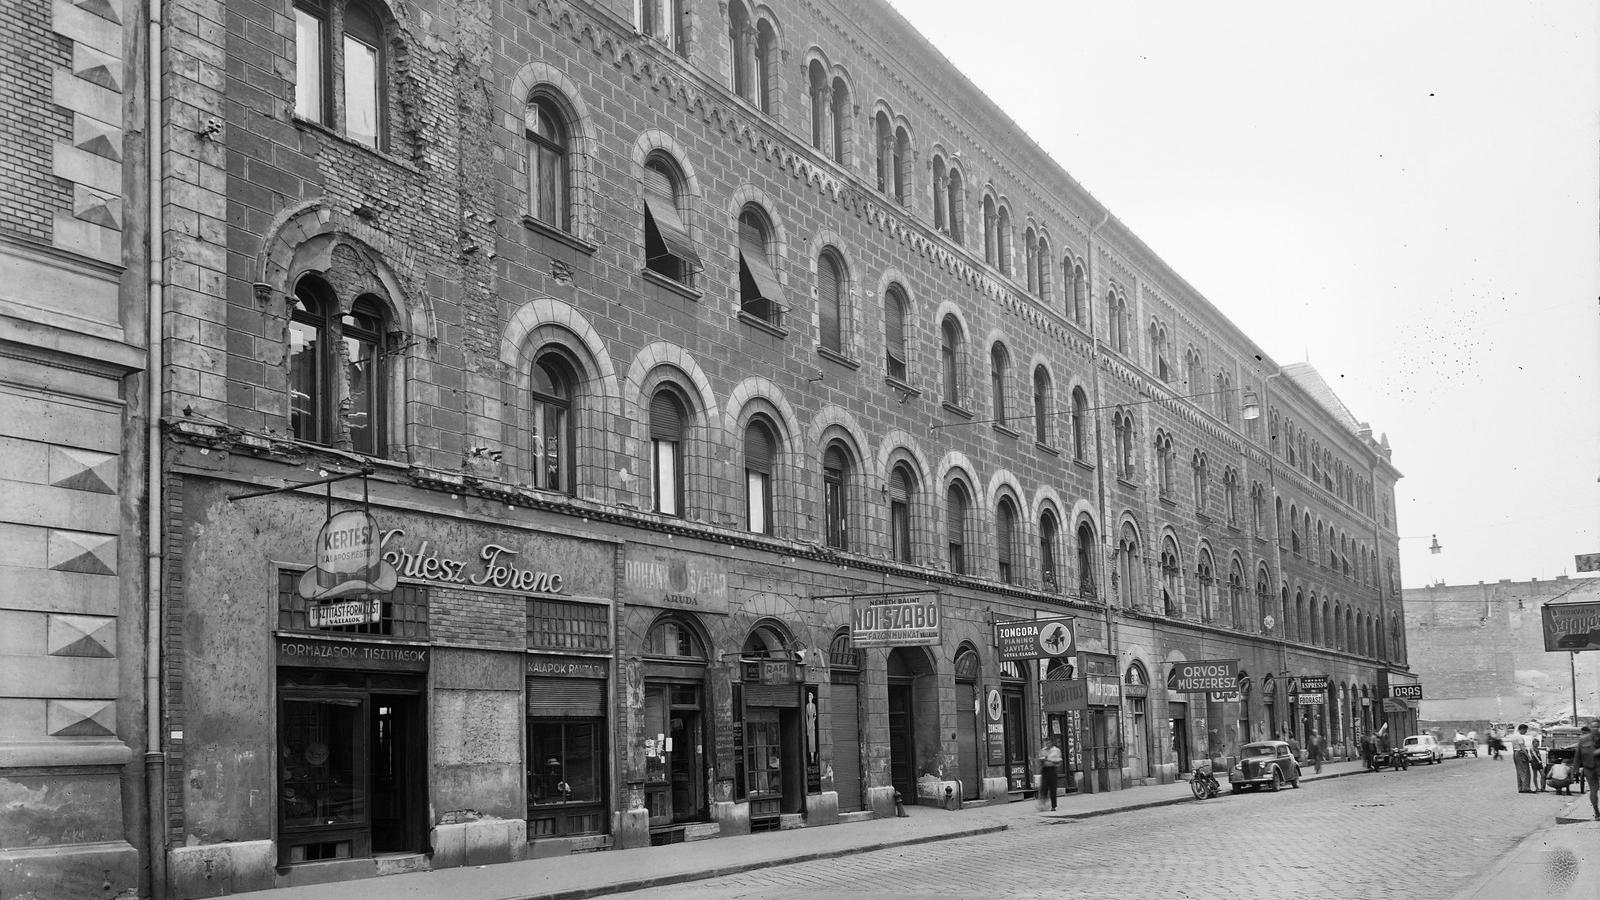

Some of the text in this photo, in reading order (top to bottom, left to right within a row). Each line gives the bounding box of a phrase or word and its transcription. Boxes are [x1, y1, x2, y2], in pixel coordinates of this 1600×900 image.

[470, 544, 563, 593] Ferenc
[1000, 626, 1039, 639] ZONGORA
[528, 662, 566, 674] KALAPOK
[1183, 665, 1229, 677] ORVOSI
